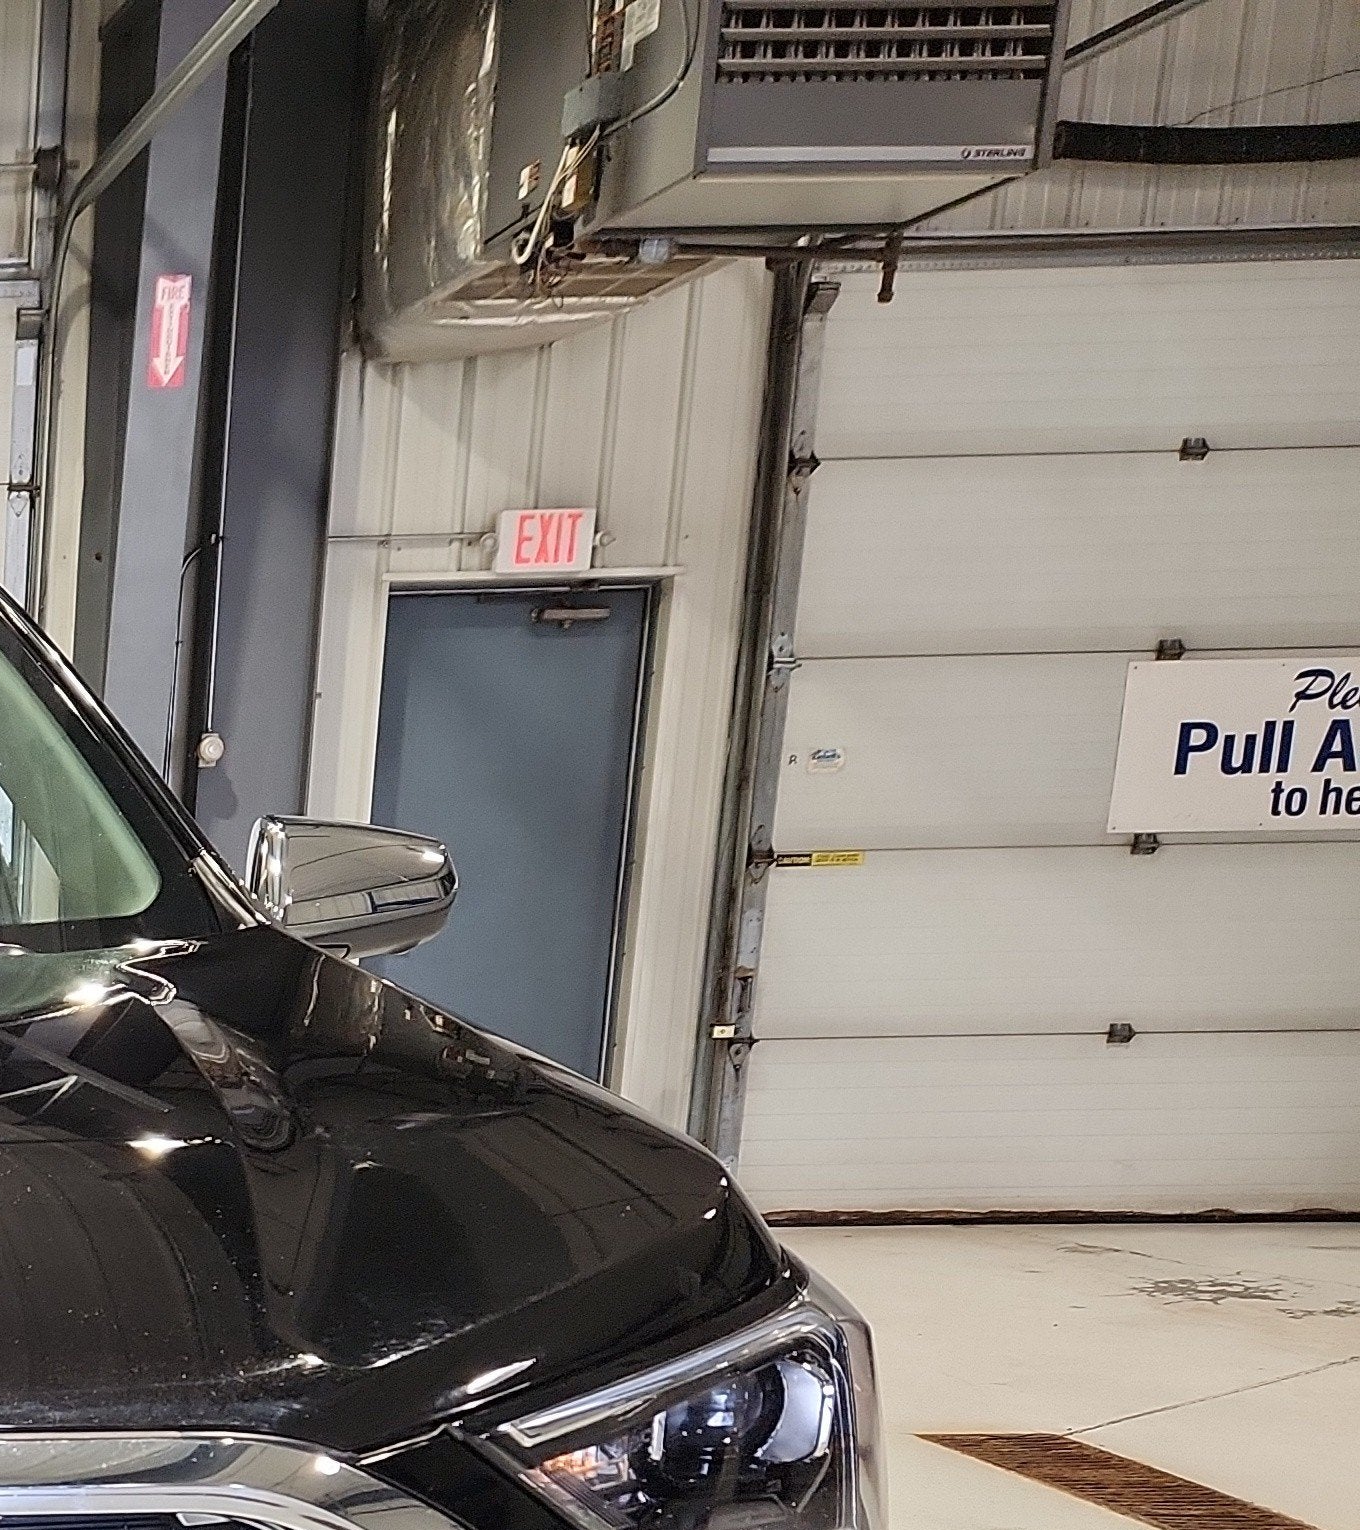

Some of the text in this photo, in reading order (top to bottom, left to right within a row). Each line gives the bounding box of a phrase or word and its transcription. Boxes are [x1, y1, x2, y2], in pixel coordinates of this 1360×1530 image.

[973, 147, 1026, 157] STERLING
[160, 285, 186, 301] FIRE
[514, 513, 582, 564] EXIT
[1288, 668, 1360, 713] Ple
[1173, 719, 1295, 775] Pull
[1270, 780, 1308, 816] to
